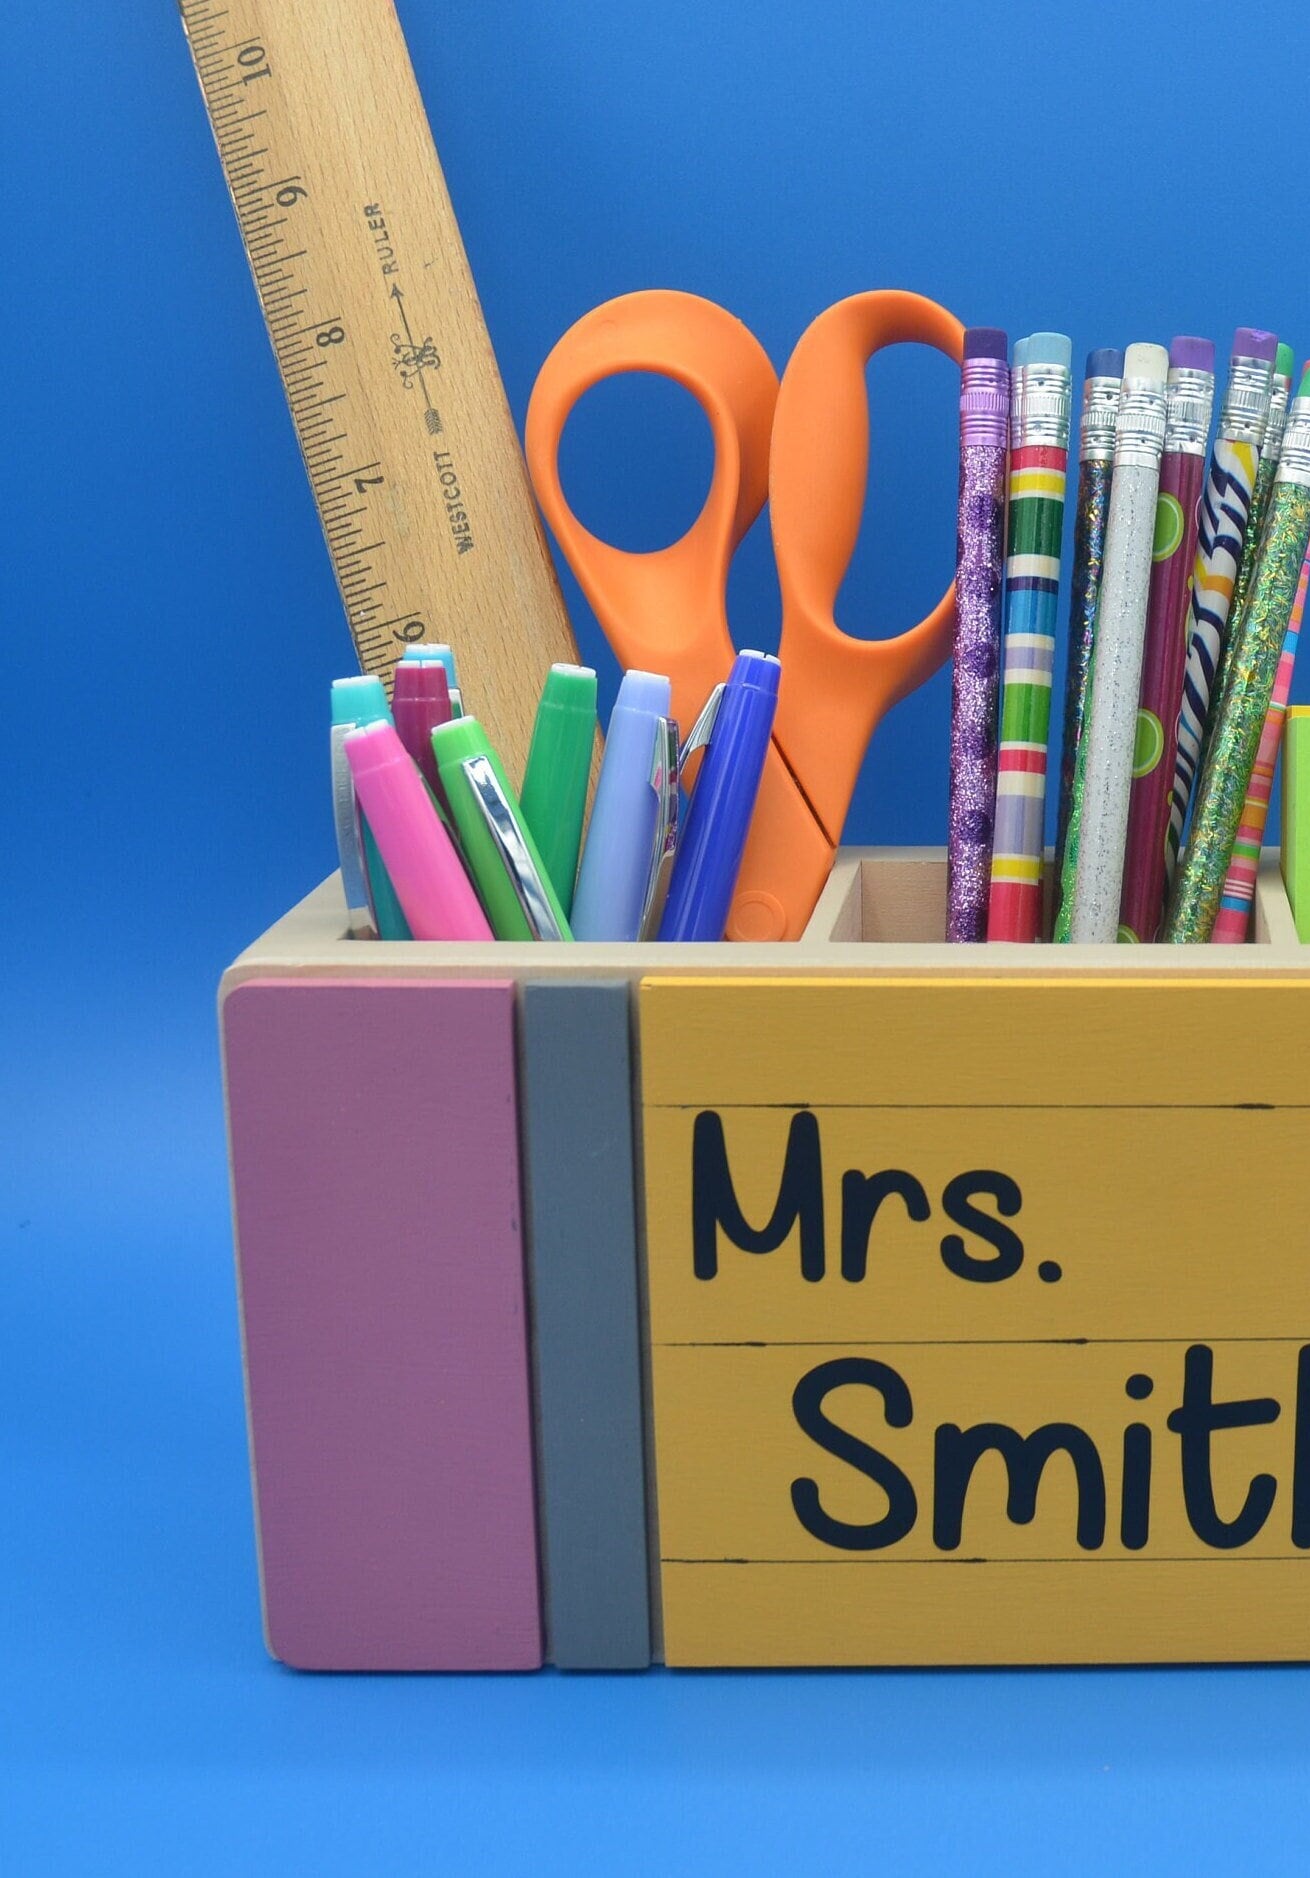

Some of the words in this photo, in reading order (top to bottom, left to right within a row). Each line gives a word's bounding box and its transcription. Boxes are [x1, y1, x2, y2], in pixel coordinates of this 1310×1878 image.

[237, 45, 272, 87] 10
[276, 185, 308, 208] 9
[363, 202, 400, 276] RULER
[315, 326, 346, 348] 8
[355, 475, 385, 494] 7
[433, 450, 475, 556] WESTCOTT
[392, 620, 425, 643] 6
[692, 1110, 1063, 1284] Mrs.
